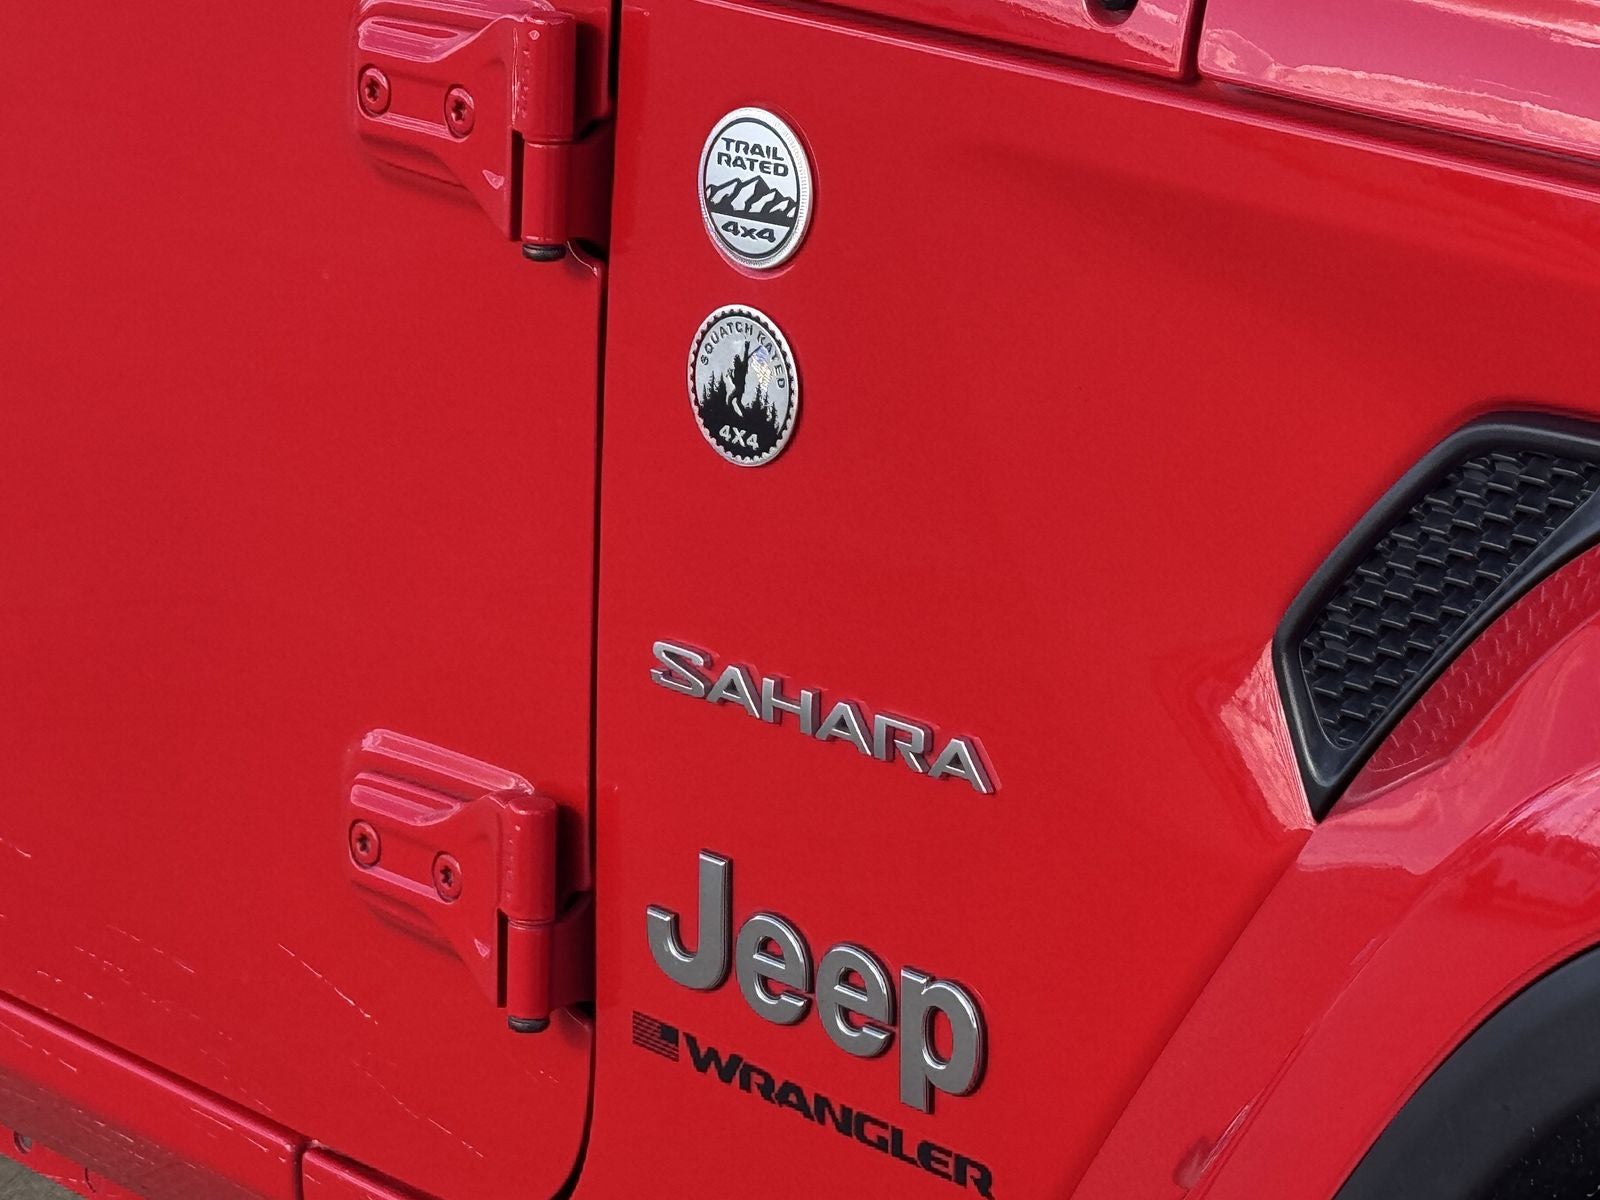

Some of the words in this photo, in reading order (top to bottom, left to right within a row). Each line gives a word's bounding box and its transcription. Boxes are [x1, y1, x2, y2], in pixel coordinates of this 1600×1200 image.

[717, 152, 789, 177] RATED
[721, 137, 785, 161] TRAIL
[700, 321, 753, 366] SQUATCH
[757, 331, 786, 389] RATED
[650, 640, 997, 795] SAHARA
[646, 848, 989, 1115] Jeep
[683, 1032, 995, 1200] WRANGLER
